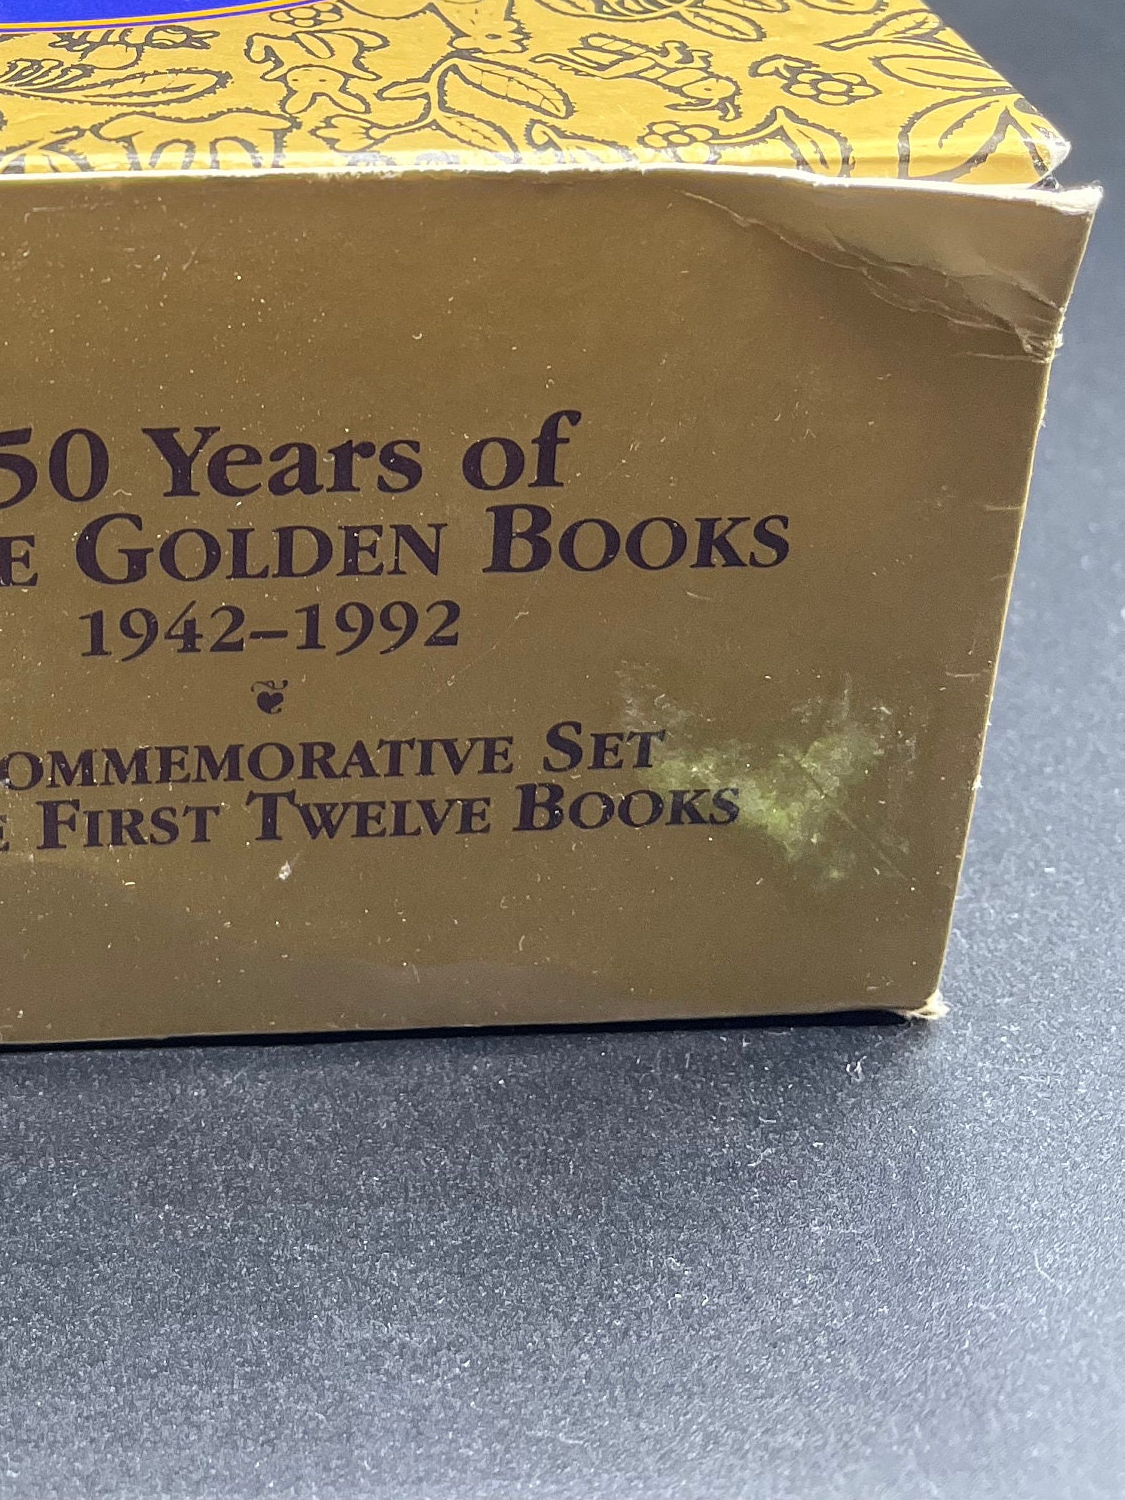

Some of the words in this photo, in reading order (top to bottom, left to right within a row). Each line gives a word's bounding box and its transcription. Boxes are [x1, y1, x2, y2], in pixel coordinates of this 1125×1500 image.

[142, 424, 422, 500] Years
[463, 408, 582, 491] of
[76, 514, 446, 585] GOLDEN
[483, 502, 791, 573] BOOKS
[541, 720, 665, 771] SET
[35, 799, 222, 851] FIRST
[246, 789, 491, 843] TWELVE
[513, 782, 742, 833] BOOKS
